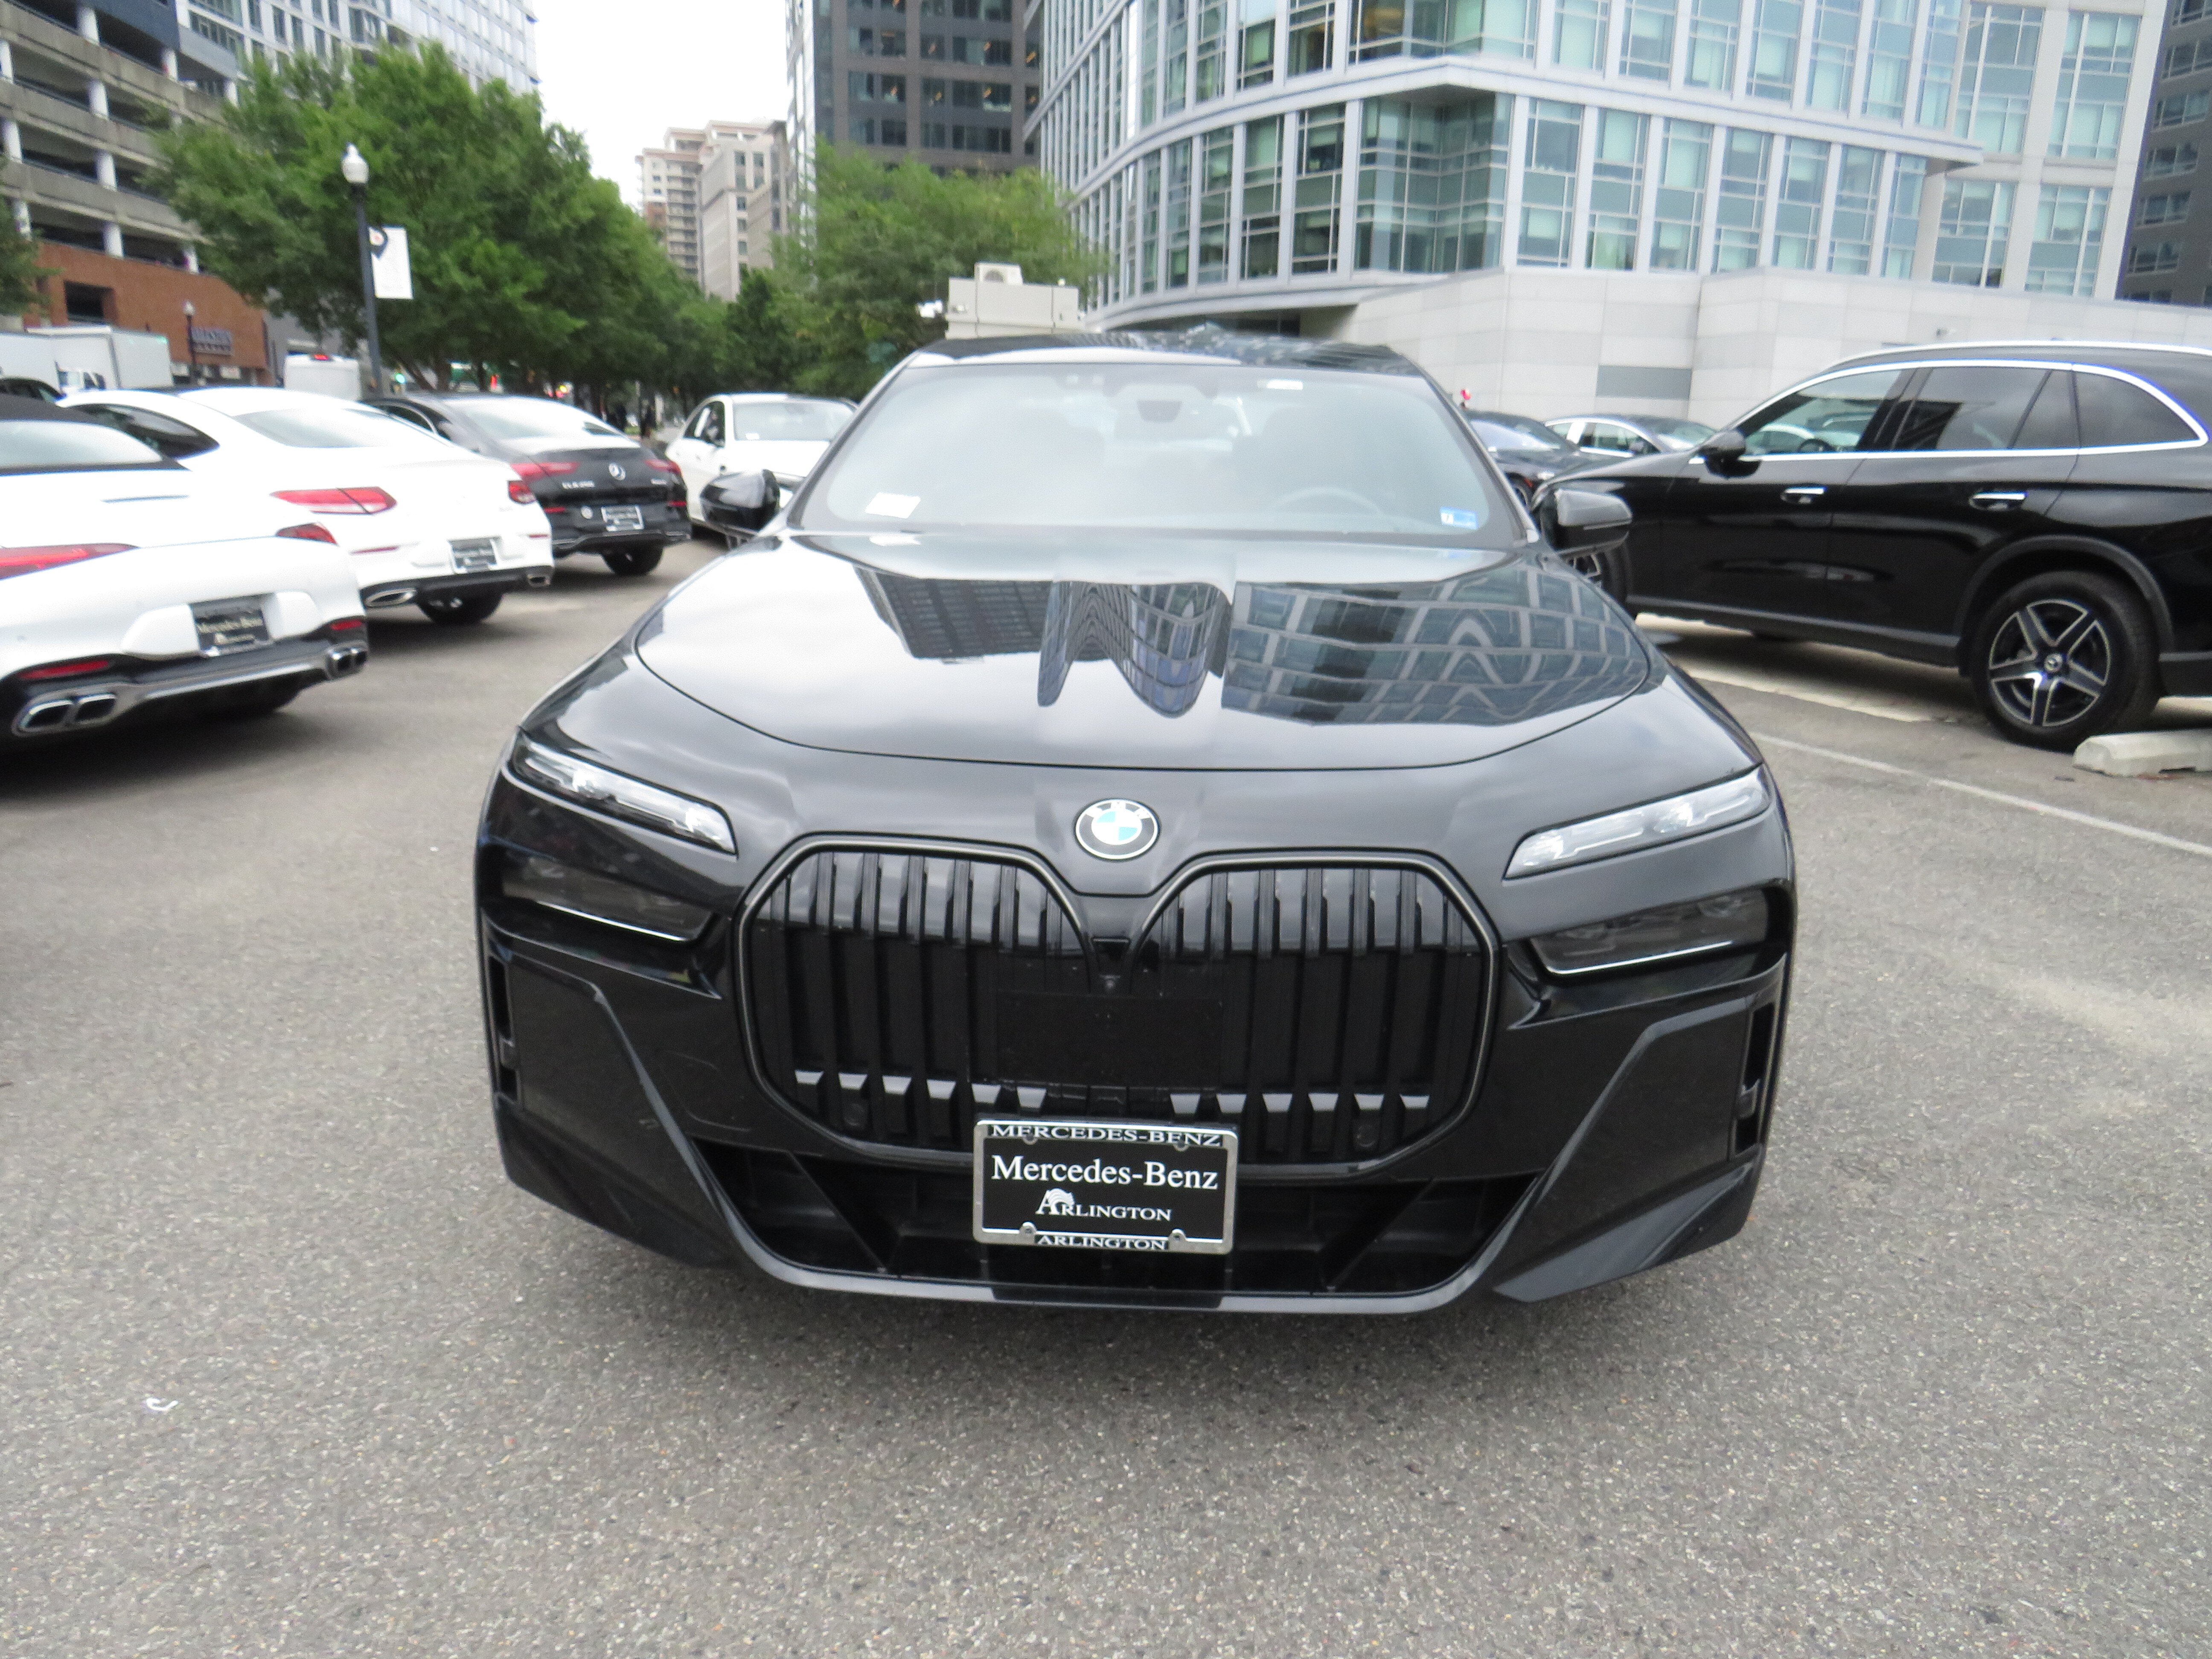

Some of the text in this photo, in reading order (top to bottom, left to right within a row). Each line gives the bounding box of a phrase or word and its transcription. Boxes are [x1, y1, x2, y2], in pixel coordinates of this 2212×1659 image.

[992, 1124, 1220, 1147] MERCEDES-BENZ
[991, 1155, 1219, 1190] Mercedes-Benz
[1035, 1189, 1172, 1222] ARLINGTON
[1037, 1235, 1166, 1250] ARLINGTON
